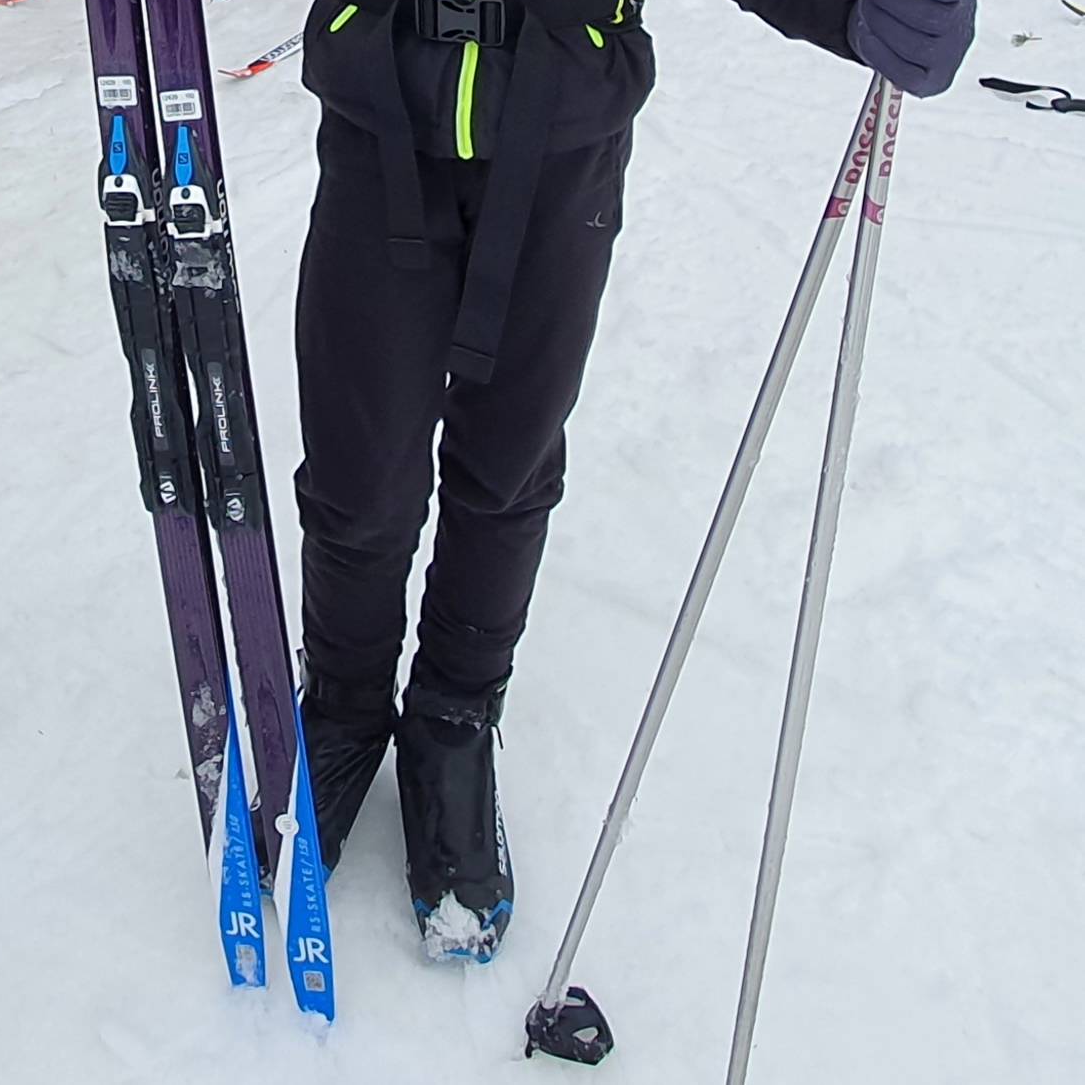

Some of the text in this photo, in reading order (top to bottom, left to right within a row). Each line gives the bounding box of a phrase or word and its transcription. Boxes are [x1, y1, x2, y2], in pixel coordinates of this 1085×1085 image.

[145, 363, 165, 438] PROLINK
[213, 377, 231, 453] PROLINK
[225, 911, 260, 938] JR
[293, 936, 329, 964] JR
